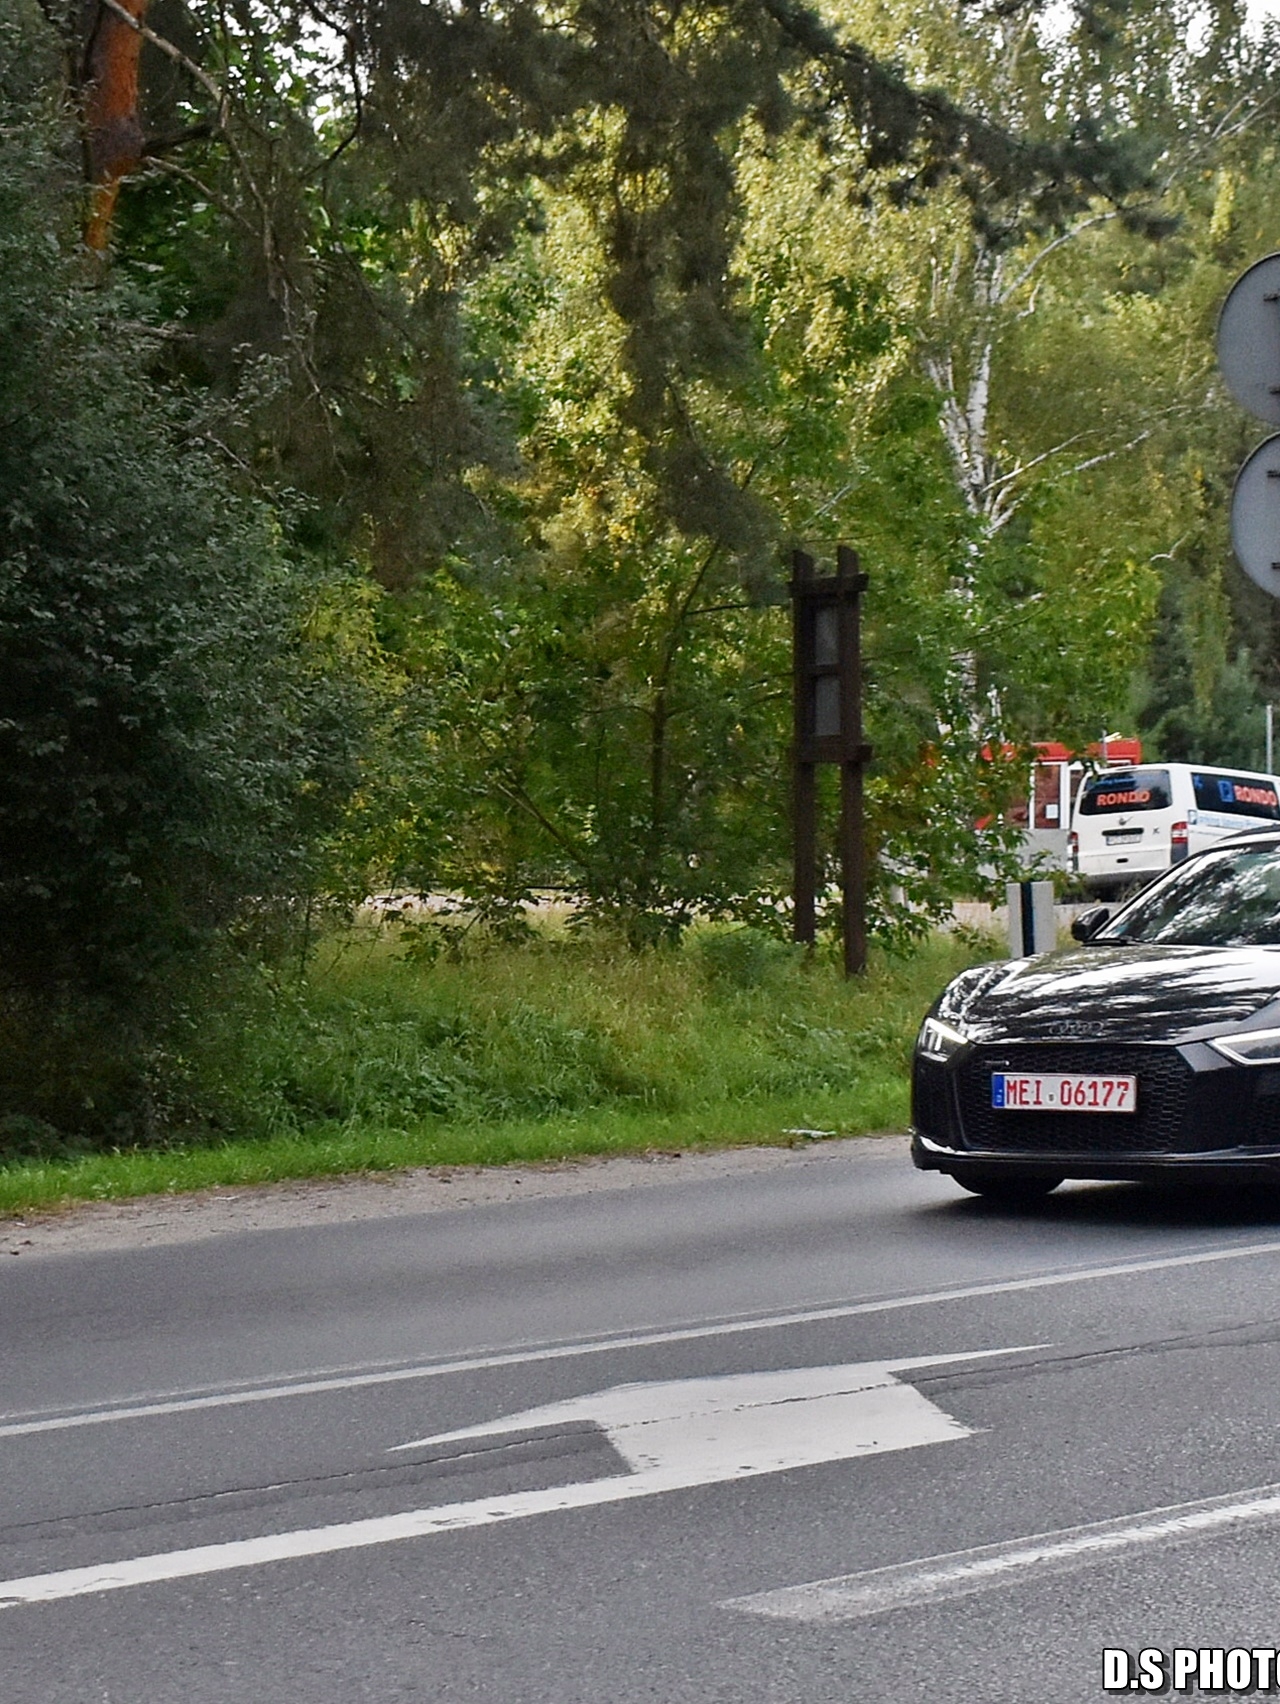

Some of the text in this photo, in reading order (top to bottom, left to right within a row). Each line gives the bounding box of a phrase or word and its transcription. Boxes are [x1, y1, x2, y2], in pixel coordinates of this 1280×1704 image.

[1096, 790, 1151, 806] RONDO
[1234, 784, 1278, 806] RONDO
[1006, 1079, 1129, 1106] MEI 06177
